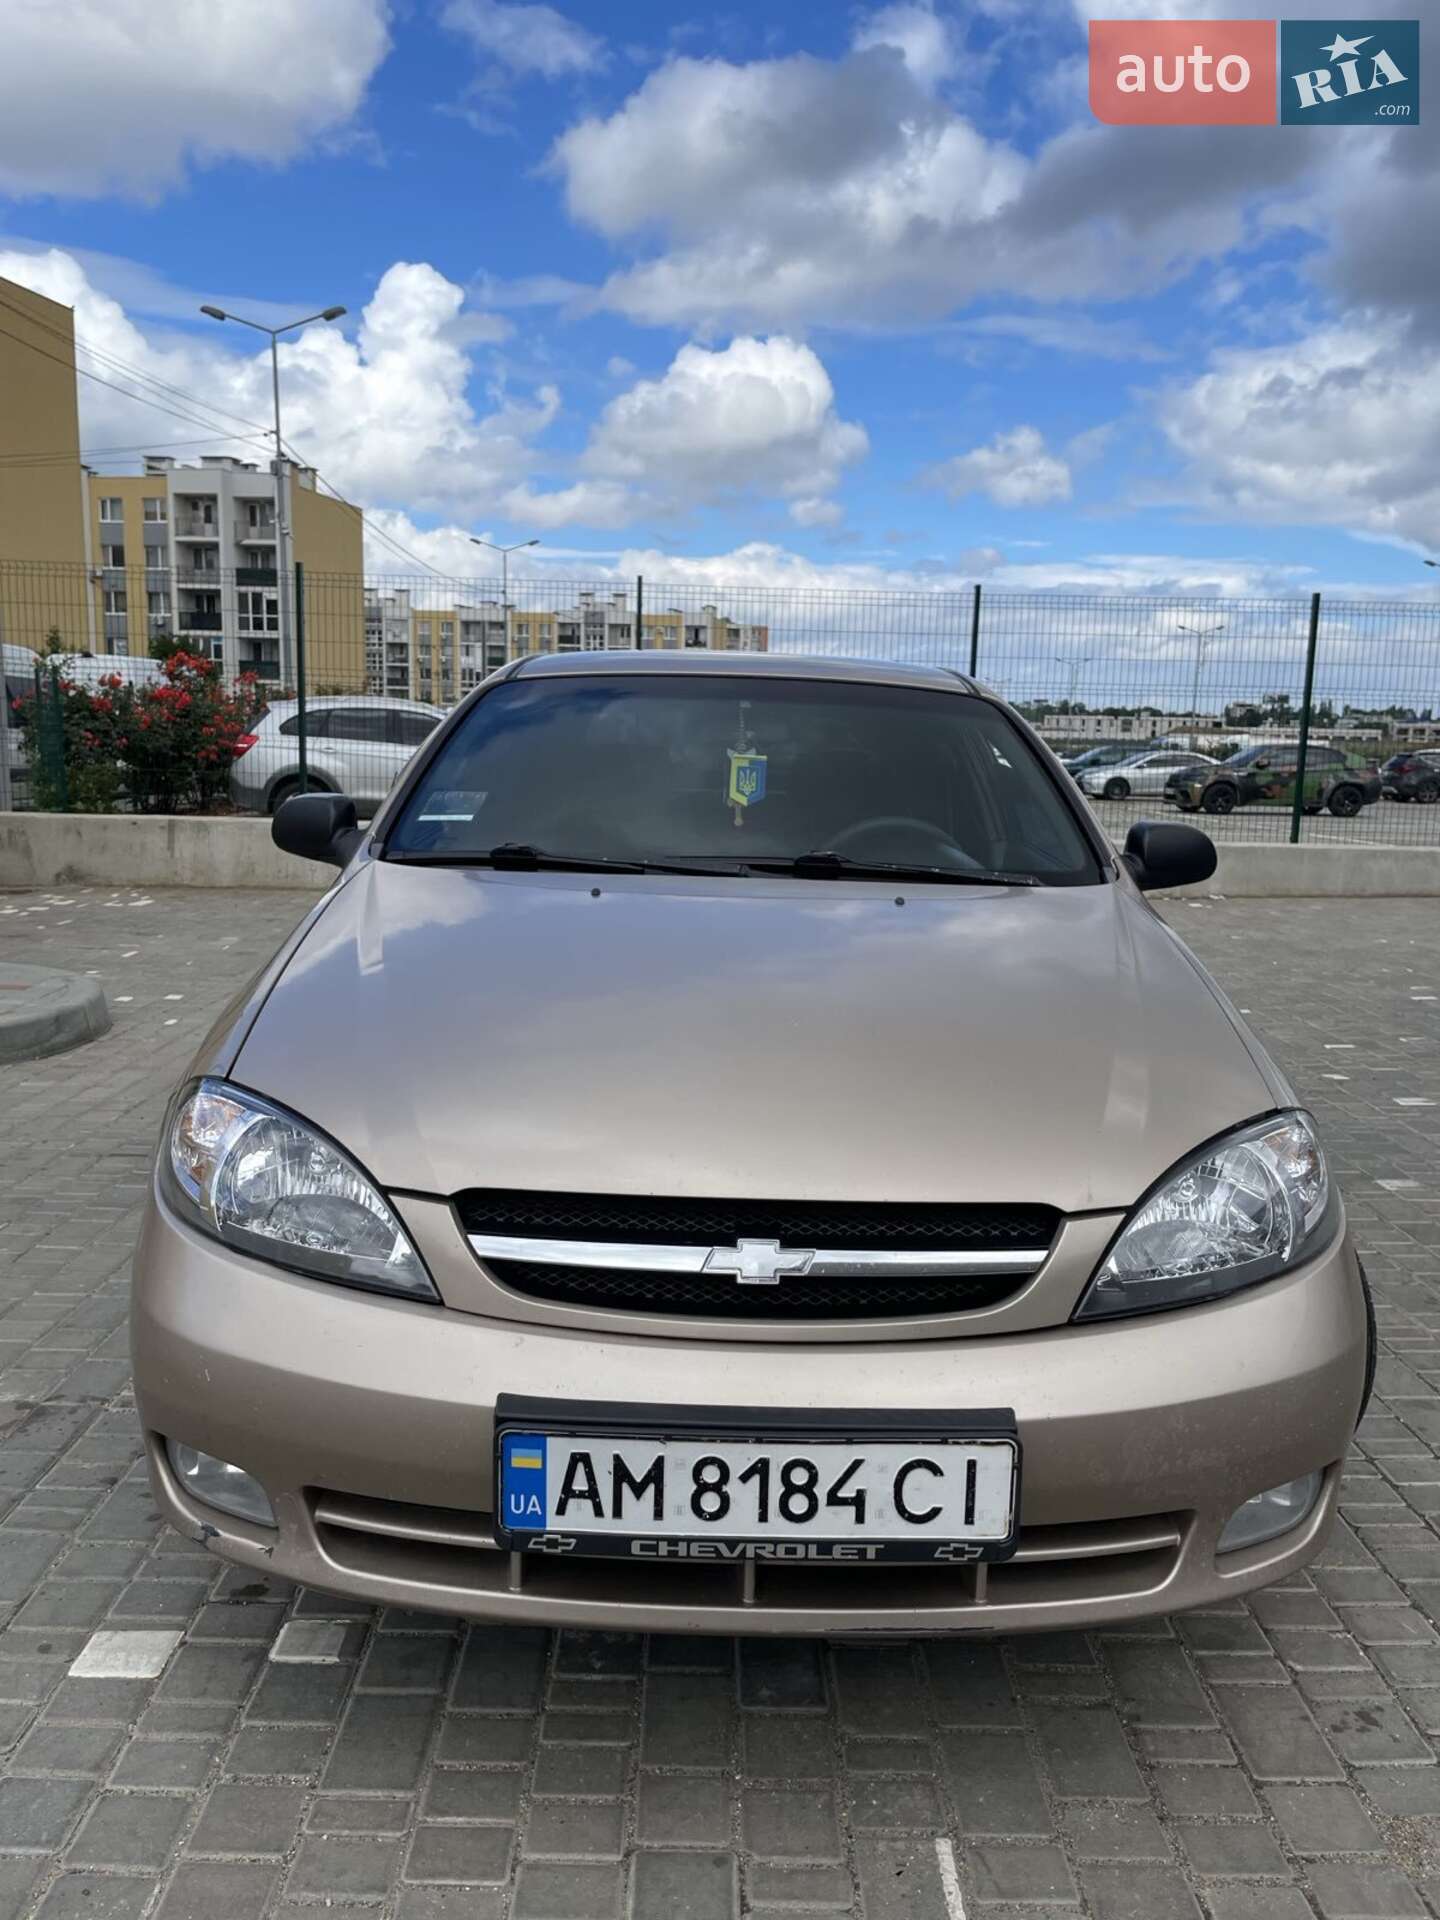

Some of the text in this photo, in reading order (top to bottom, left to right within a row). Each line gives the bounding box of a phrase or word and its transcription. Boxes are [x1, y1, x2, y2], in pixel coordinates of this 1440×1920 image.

[555, 1451, 976, 1526] AM 8184 CI
[510, 1494, 542, 1515] UA
[630, 1539, 885, 1560] CHEVROLET
